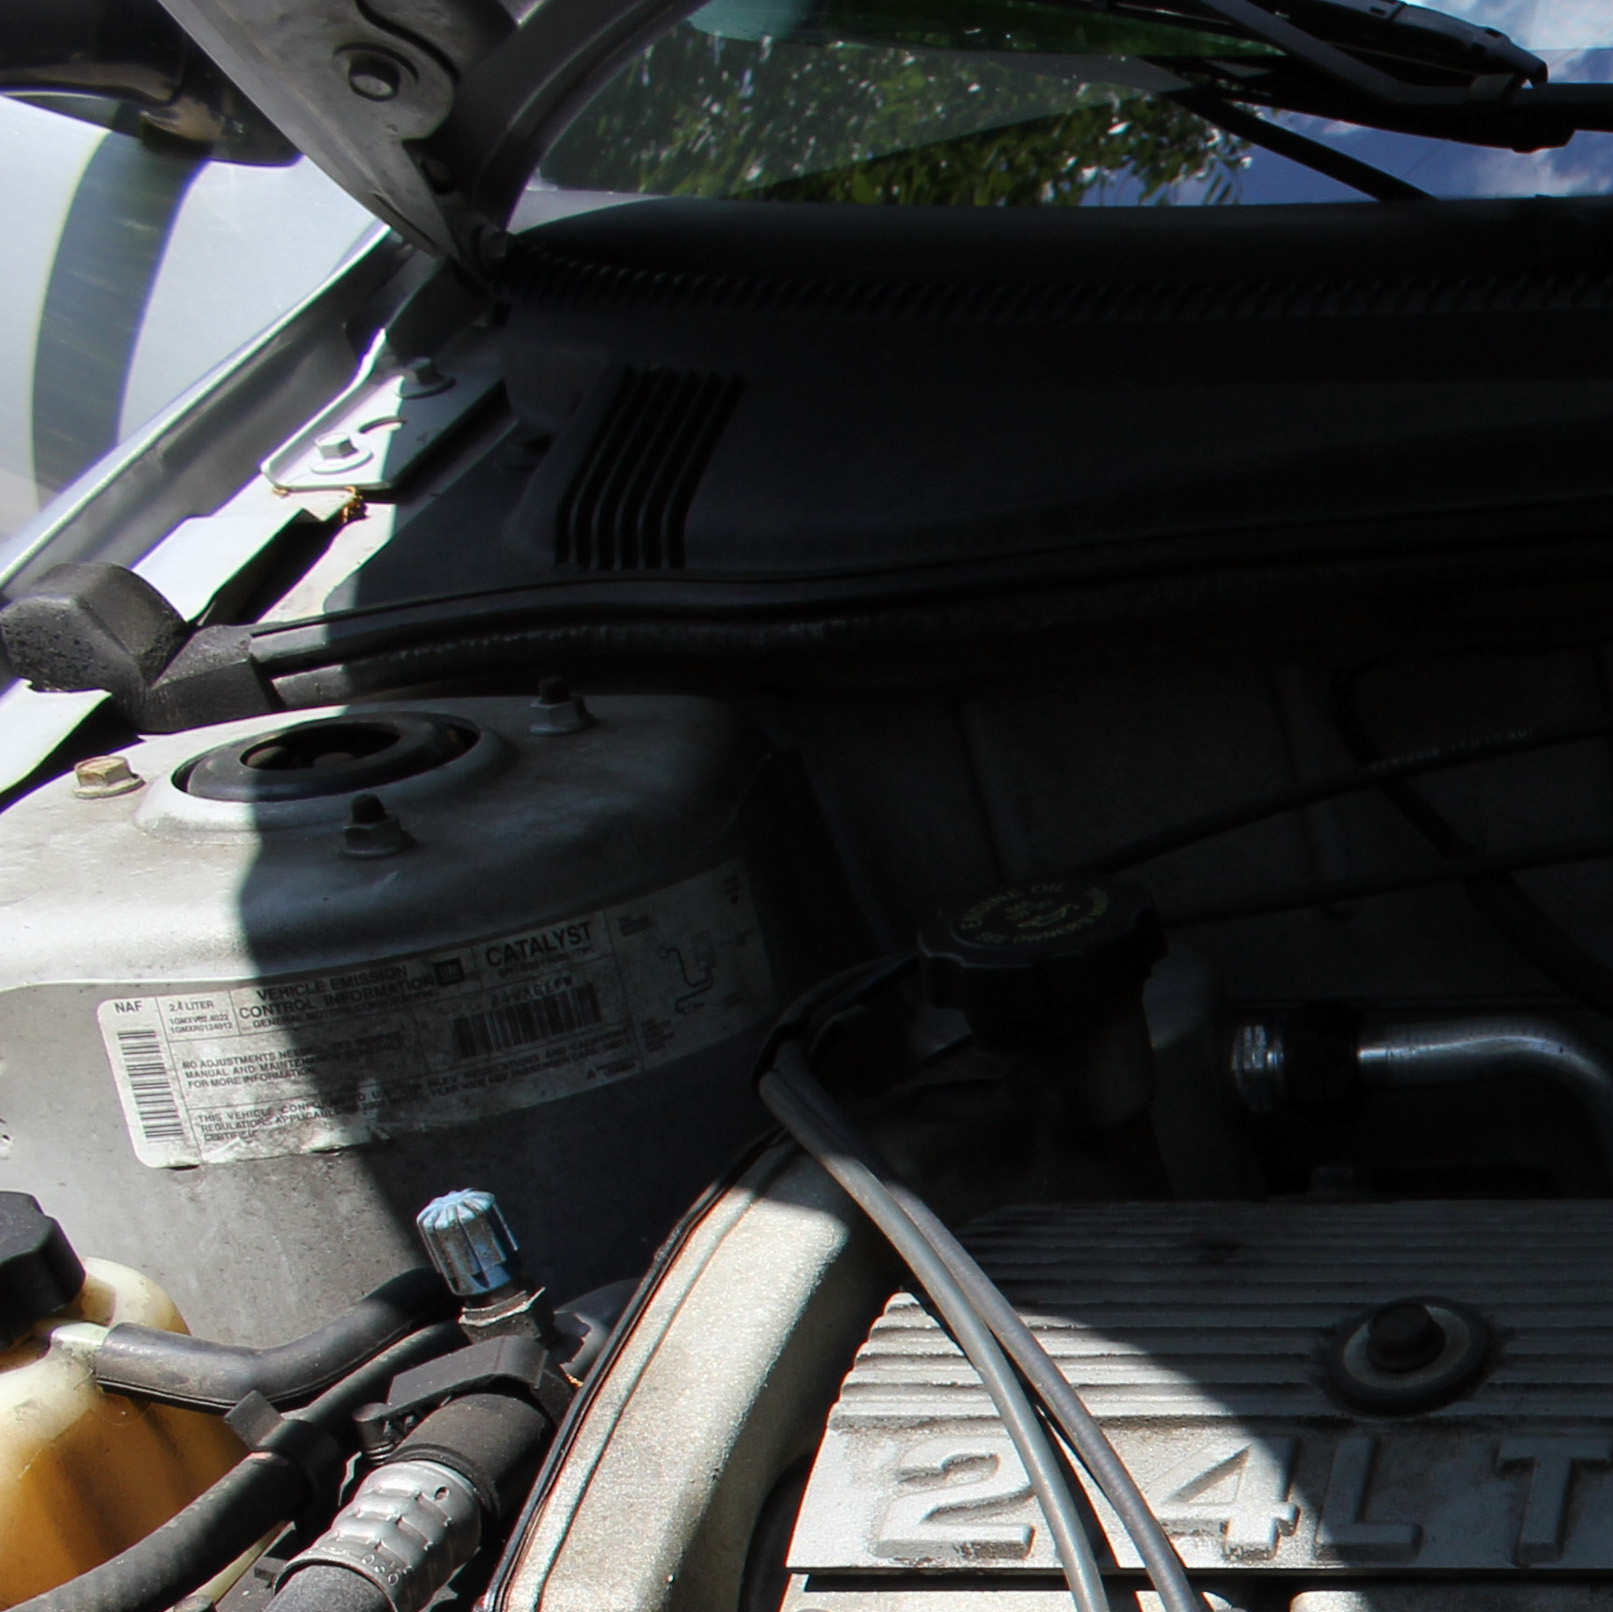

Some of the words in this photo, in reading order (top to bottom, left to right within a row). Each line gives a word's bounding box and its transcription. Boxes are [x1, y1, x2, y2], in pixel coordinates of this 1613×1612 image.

[485, 920, 591, 967] CATALYST
[257, 979, 325, 1002] VEHICLE
[330, 965, 408, 991] EMISSION
[239, 999, 316, 1020] CONTROL
[324, 973, 436, 1007] INFORMATION
[115, 1001, 143, 1014] NAF
[185, 1000, 214, 1011] LITER
[252, 1013, 303, 1029] GENERAL
[182, 1059, 198, 1070] NO
[199, 1051, 277, 1069] ADJUSTMENTS
[185, 1066, 228, 1079] MANUAL
[232, 1064, 256, 1075] AND
[187, 1078, 209, 1089] FOR
[211, 1076, 241, 1087] MORE
[198, 1112, 223, 1122] THIS
